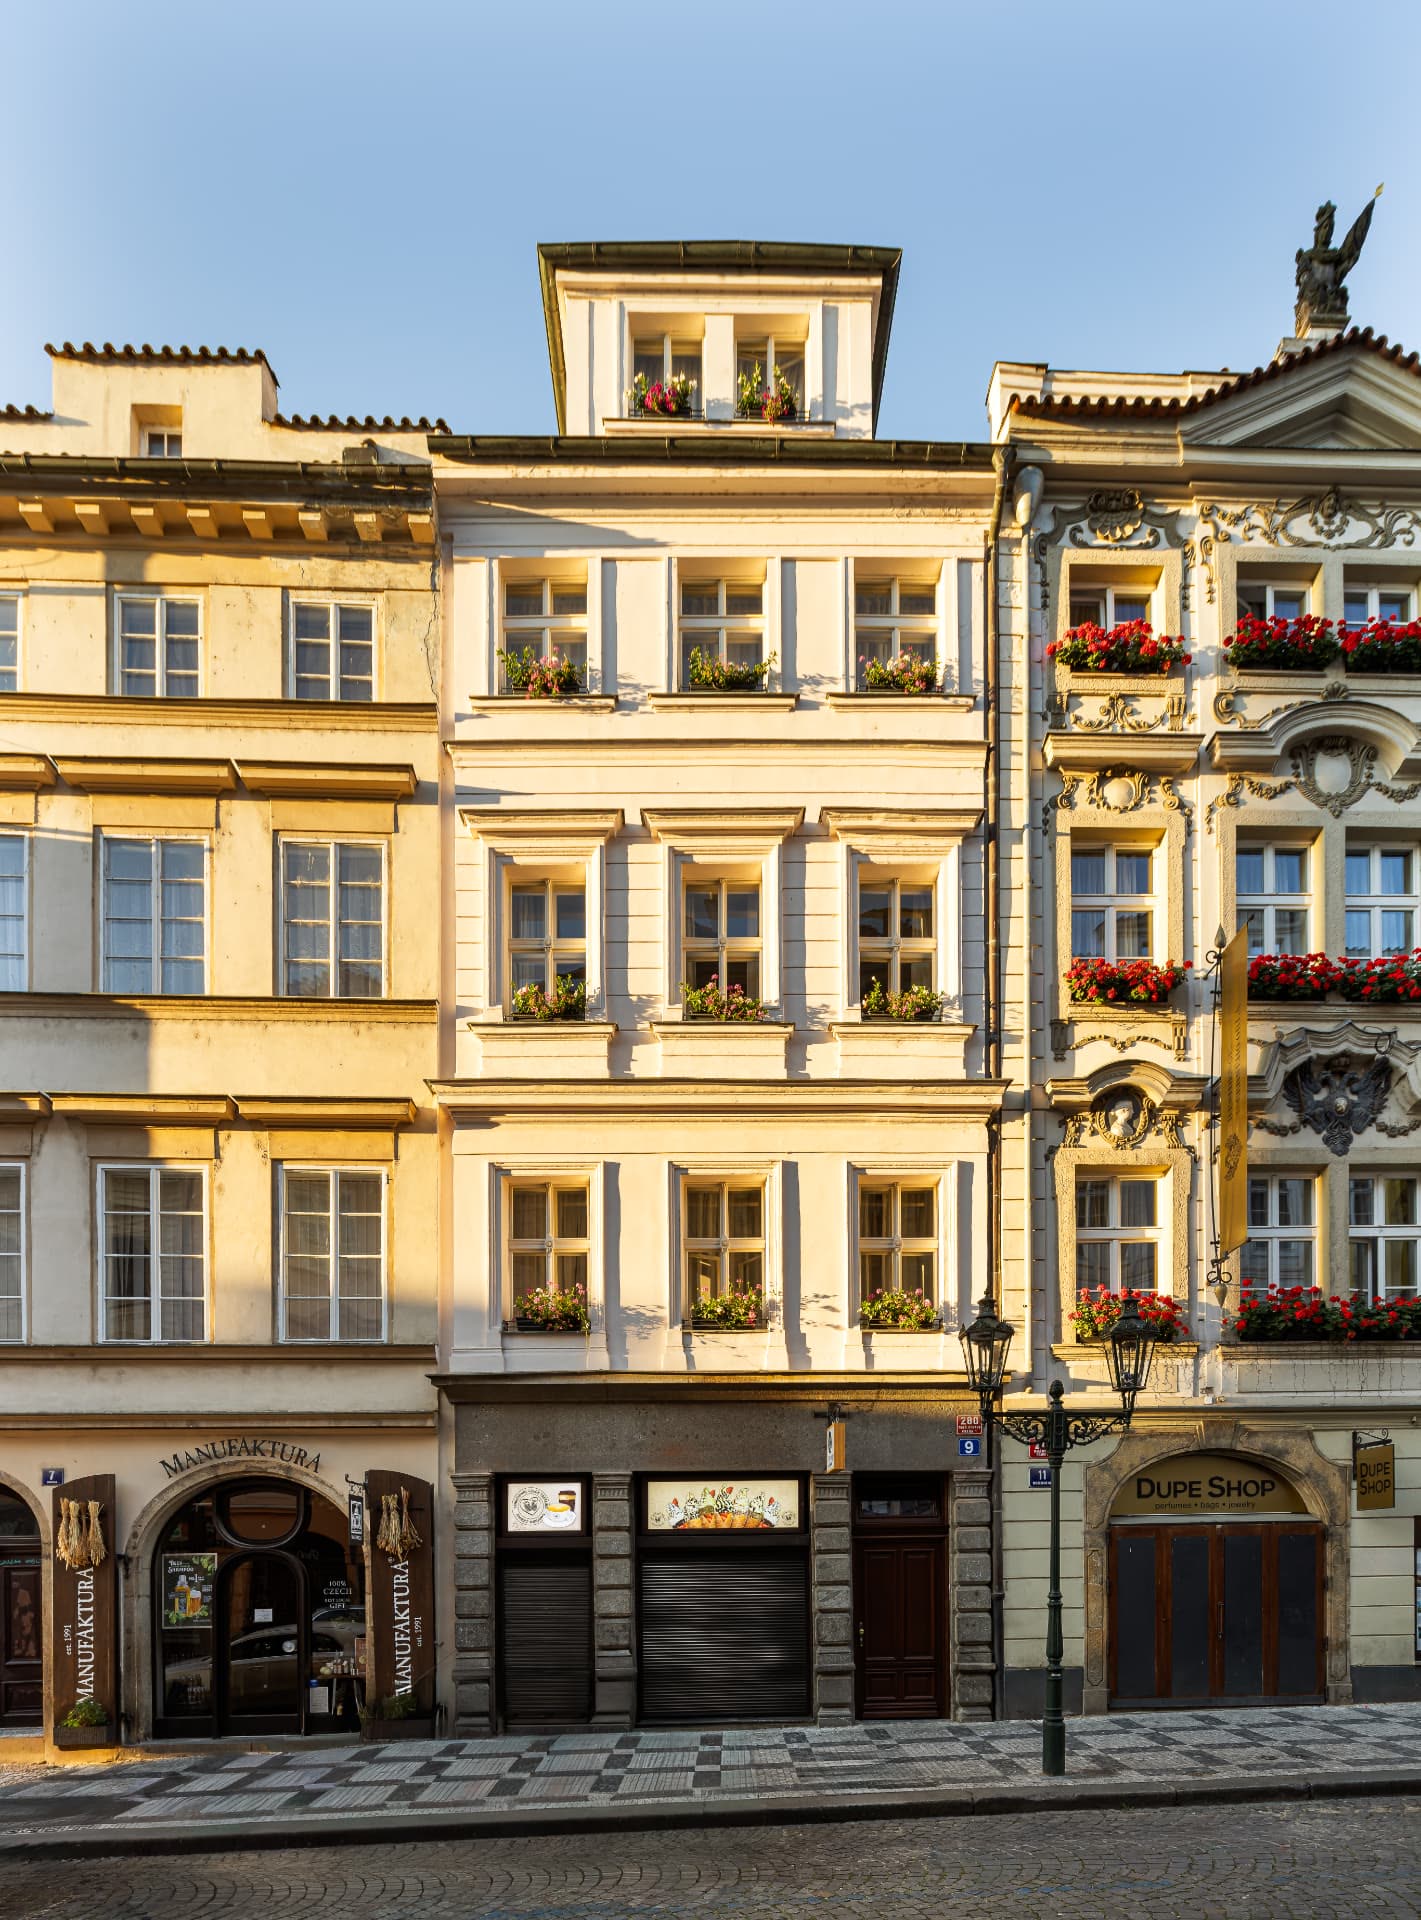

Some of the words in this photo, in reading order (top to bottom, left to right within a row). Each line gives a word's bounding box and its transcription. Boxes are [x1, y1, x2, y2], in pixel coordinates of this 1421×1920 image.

[961, 1416, 979, 1425] 280
[964, 1440, 974, 1454] 9
[159, 1437, 322, 1478] MANUFAKTURA
[49, 1470, 56, 1481] 7
[1038, 1469, 1047, 1481] 11
[1360, 1462, 1391, 1478] DUPE
[1136, 1477, 1202, 1499] DUPE
[1207, 1476, 1276, 1499] SHOP
[1360, 1479, 1391, 1495] SHOP
[1155, 1502, 1192, 1510] perfumes
[1200, 1501, 1220, 1510] bags
[1228, 1501, 1256, 1510] jewelry
[63, 1624, 72, 1641] 1991
[391, 1560, 413, 1697] MANUFAKTURA
[414, 1616, 422, 1633] 1991
[75, 1566, 95, 1705] MANUFAKTURA
